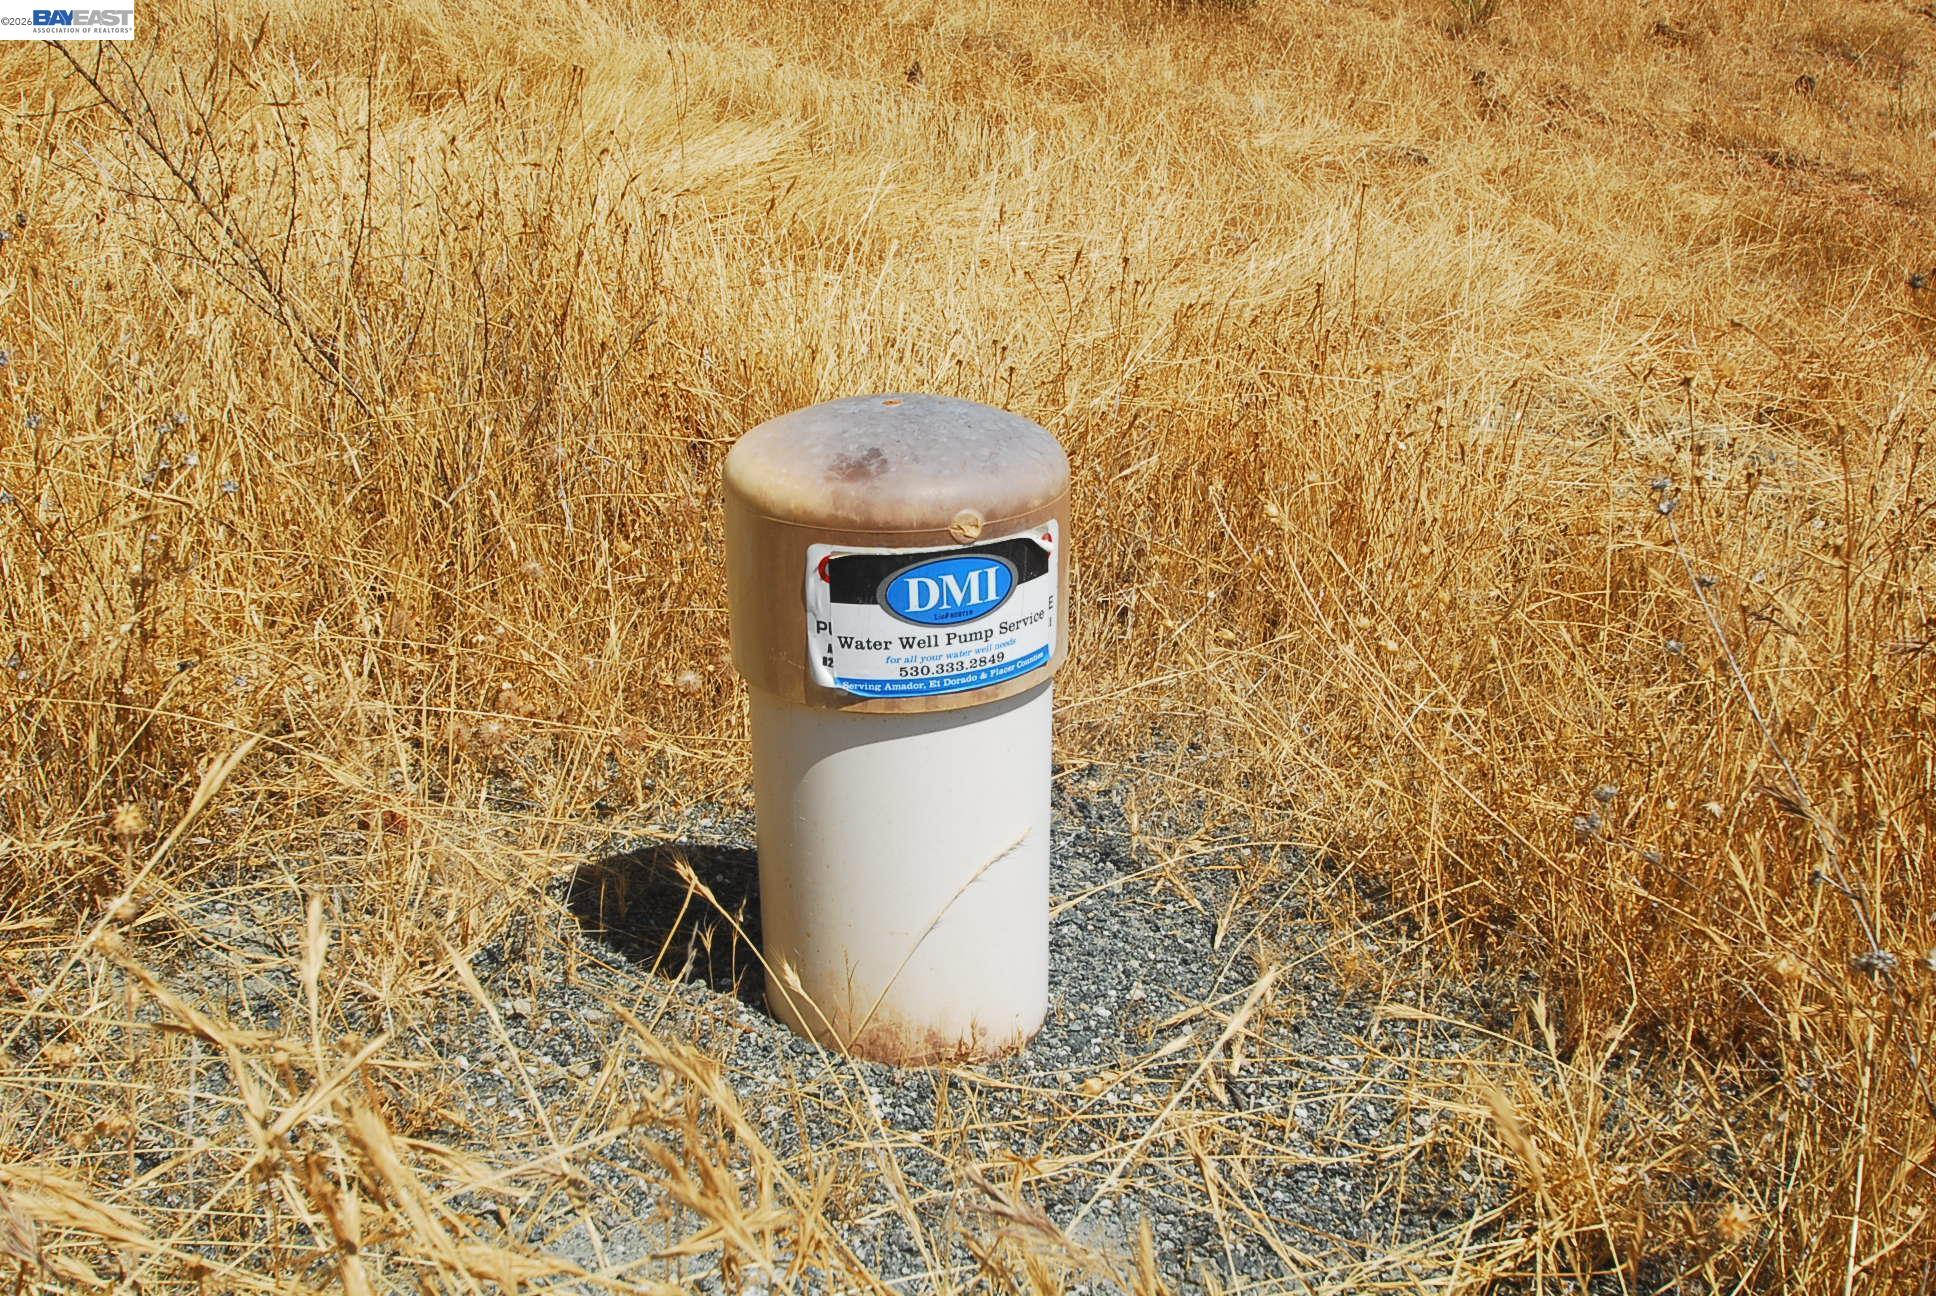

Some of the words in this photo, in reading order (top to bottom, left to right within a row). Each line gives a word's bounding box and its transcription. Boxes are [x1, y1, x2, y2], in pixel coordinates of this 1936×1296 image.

[904, 566, 999, 612] DMI
[837, 636, 892, 650] Water
[898, 634, 939, 650] Well
[946, 628, 994, 646] Pump
[999, 609, 1045, 635] Service
[842, 681, 882, 692] Serving
[929, 679, 941, 688] El
[943, 675, 978, 687] Dorado
[980, 671, 988, 680] &
[990, 665, 1015, 677] Placer
[1016, 651, 1044, 669] Counties
[885, 655, 902, 665] for
[904, 655, 917, 664] all
[920, 653, 943, 665] your
[946, 649, 972, 660] water
[975, 643, 992, 655] well
[994, 638, 1017, 651] needs
[899, 651, 1005, 678] 530.333.2849
